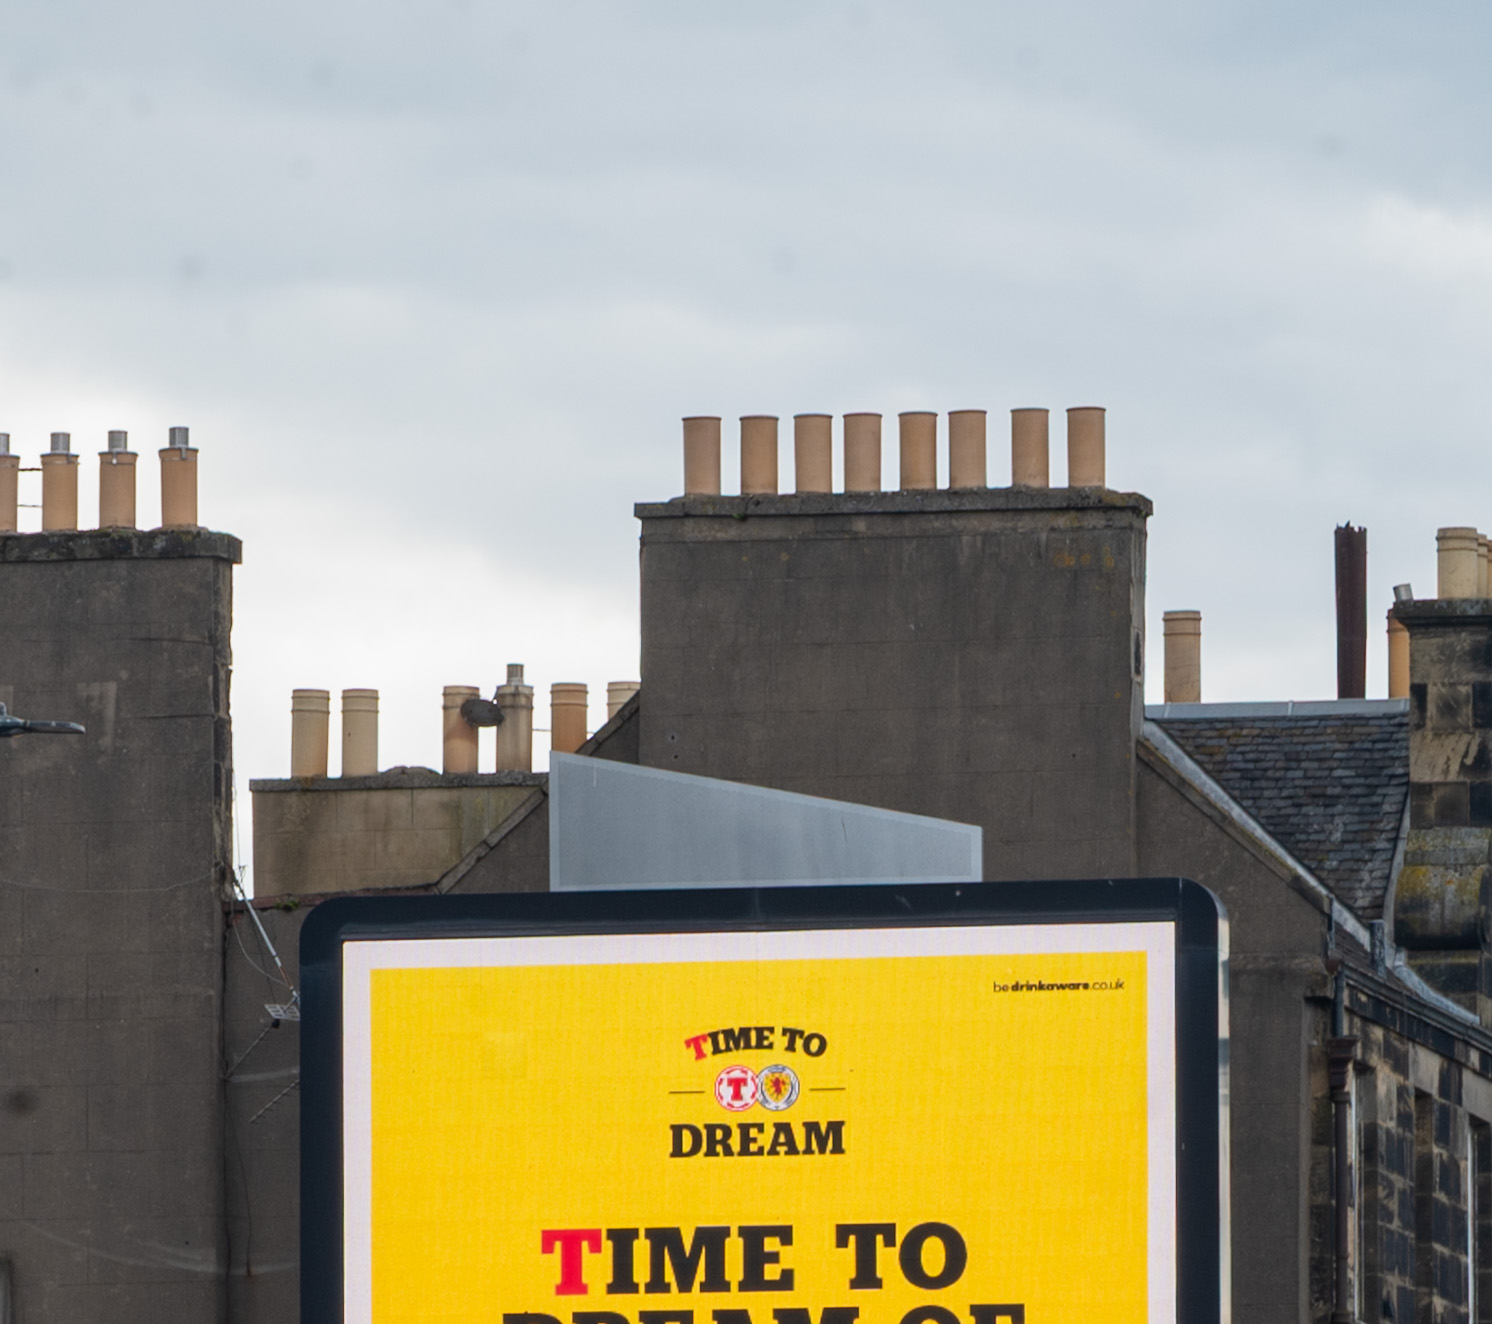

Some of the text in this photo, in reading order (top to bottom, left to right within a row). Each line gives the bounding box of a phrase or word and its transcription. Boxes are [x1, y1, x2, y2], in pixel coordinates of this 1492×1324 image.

[684, 1026, 828, 1061] TIME TO
[669, 1121, 846, 1158] DREAM
[541, 1222, 967, 1295] TIME TO
